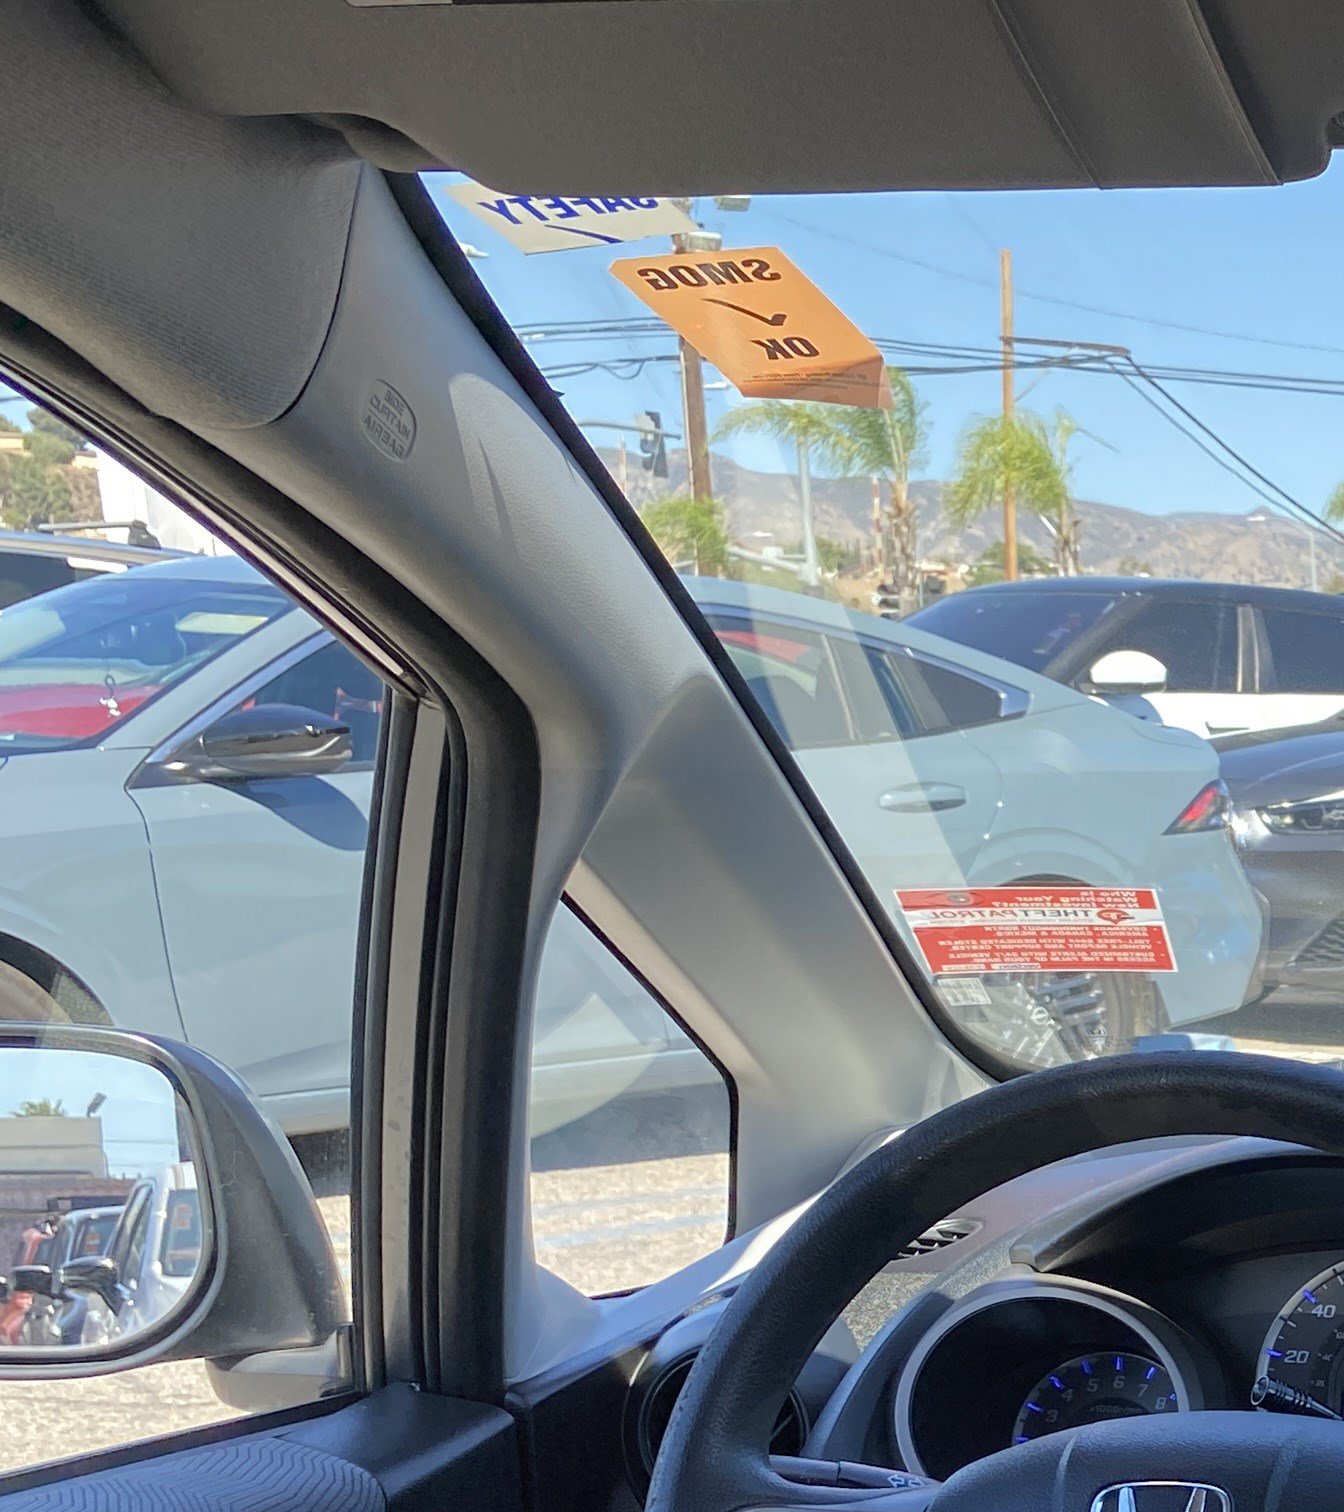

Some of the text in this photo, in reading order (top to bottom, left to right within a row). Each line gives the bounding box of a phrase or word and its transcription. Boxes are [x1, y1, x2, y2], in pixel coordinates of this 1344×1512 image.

[363, 415, 404, 458] AIRBAG
[1311, 1304, 1336, 1318] 40
[1284, 1350, 1309, 1364] 20
[1087, 1378, 1099, 1392] 5
[1113, 1375, 1125, 1389] 6
[1061, 1388, 1074, 1402] 4
[1137, 1383, 1148, 1397] 7
[1155, 1396, 1166, 1410] 8
[1045, 1409, 1059, 1423] 3
